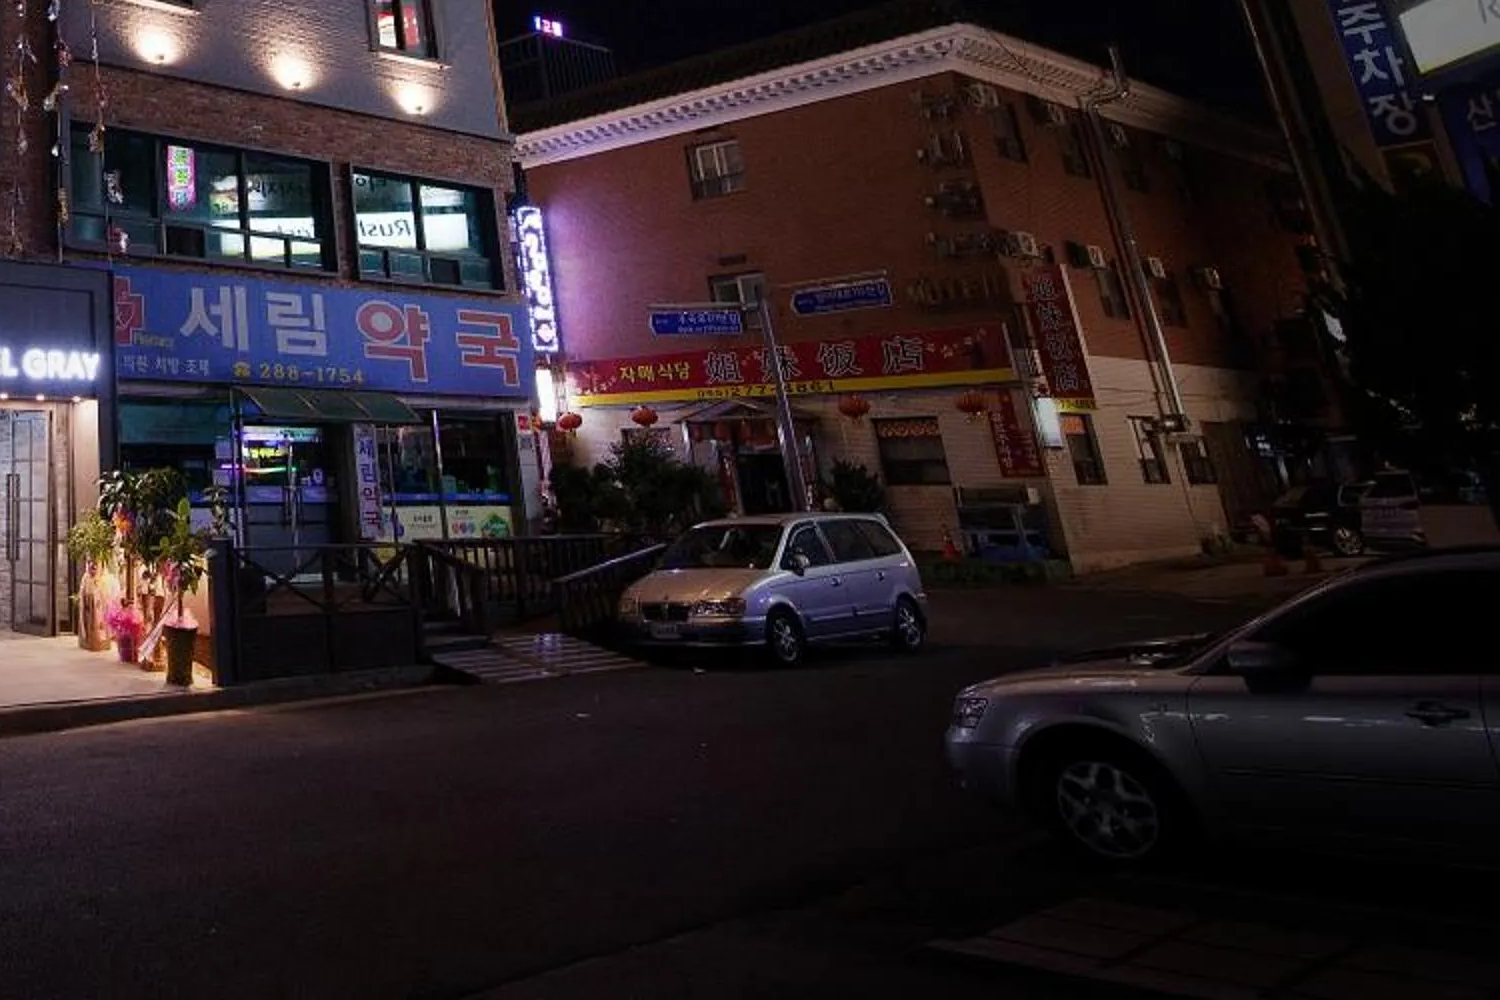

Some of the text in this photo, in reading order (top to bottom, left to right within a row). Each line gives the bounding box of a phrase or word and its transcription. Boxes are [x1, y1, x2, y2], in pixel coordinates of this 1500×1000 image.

[179, 284, 520, 387] 세림약국
[21, 347, 100, 381] GRAY
[259, 363, 365, 385] 288-1754
